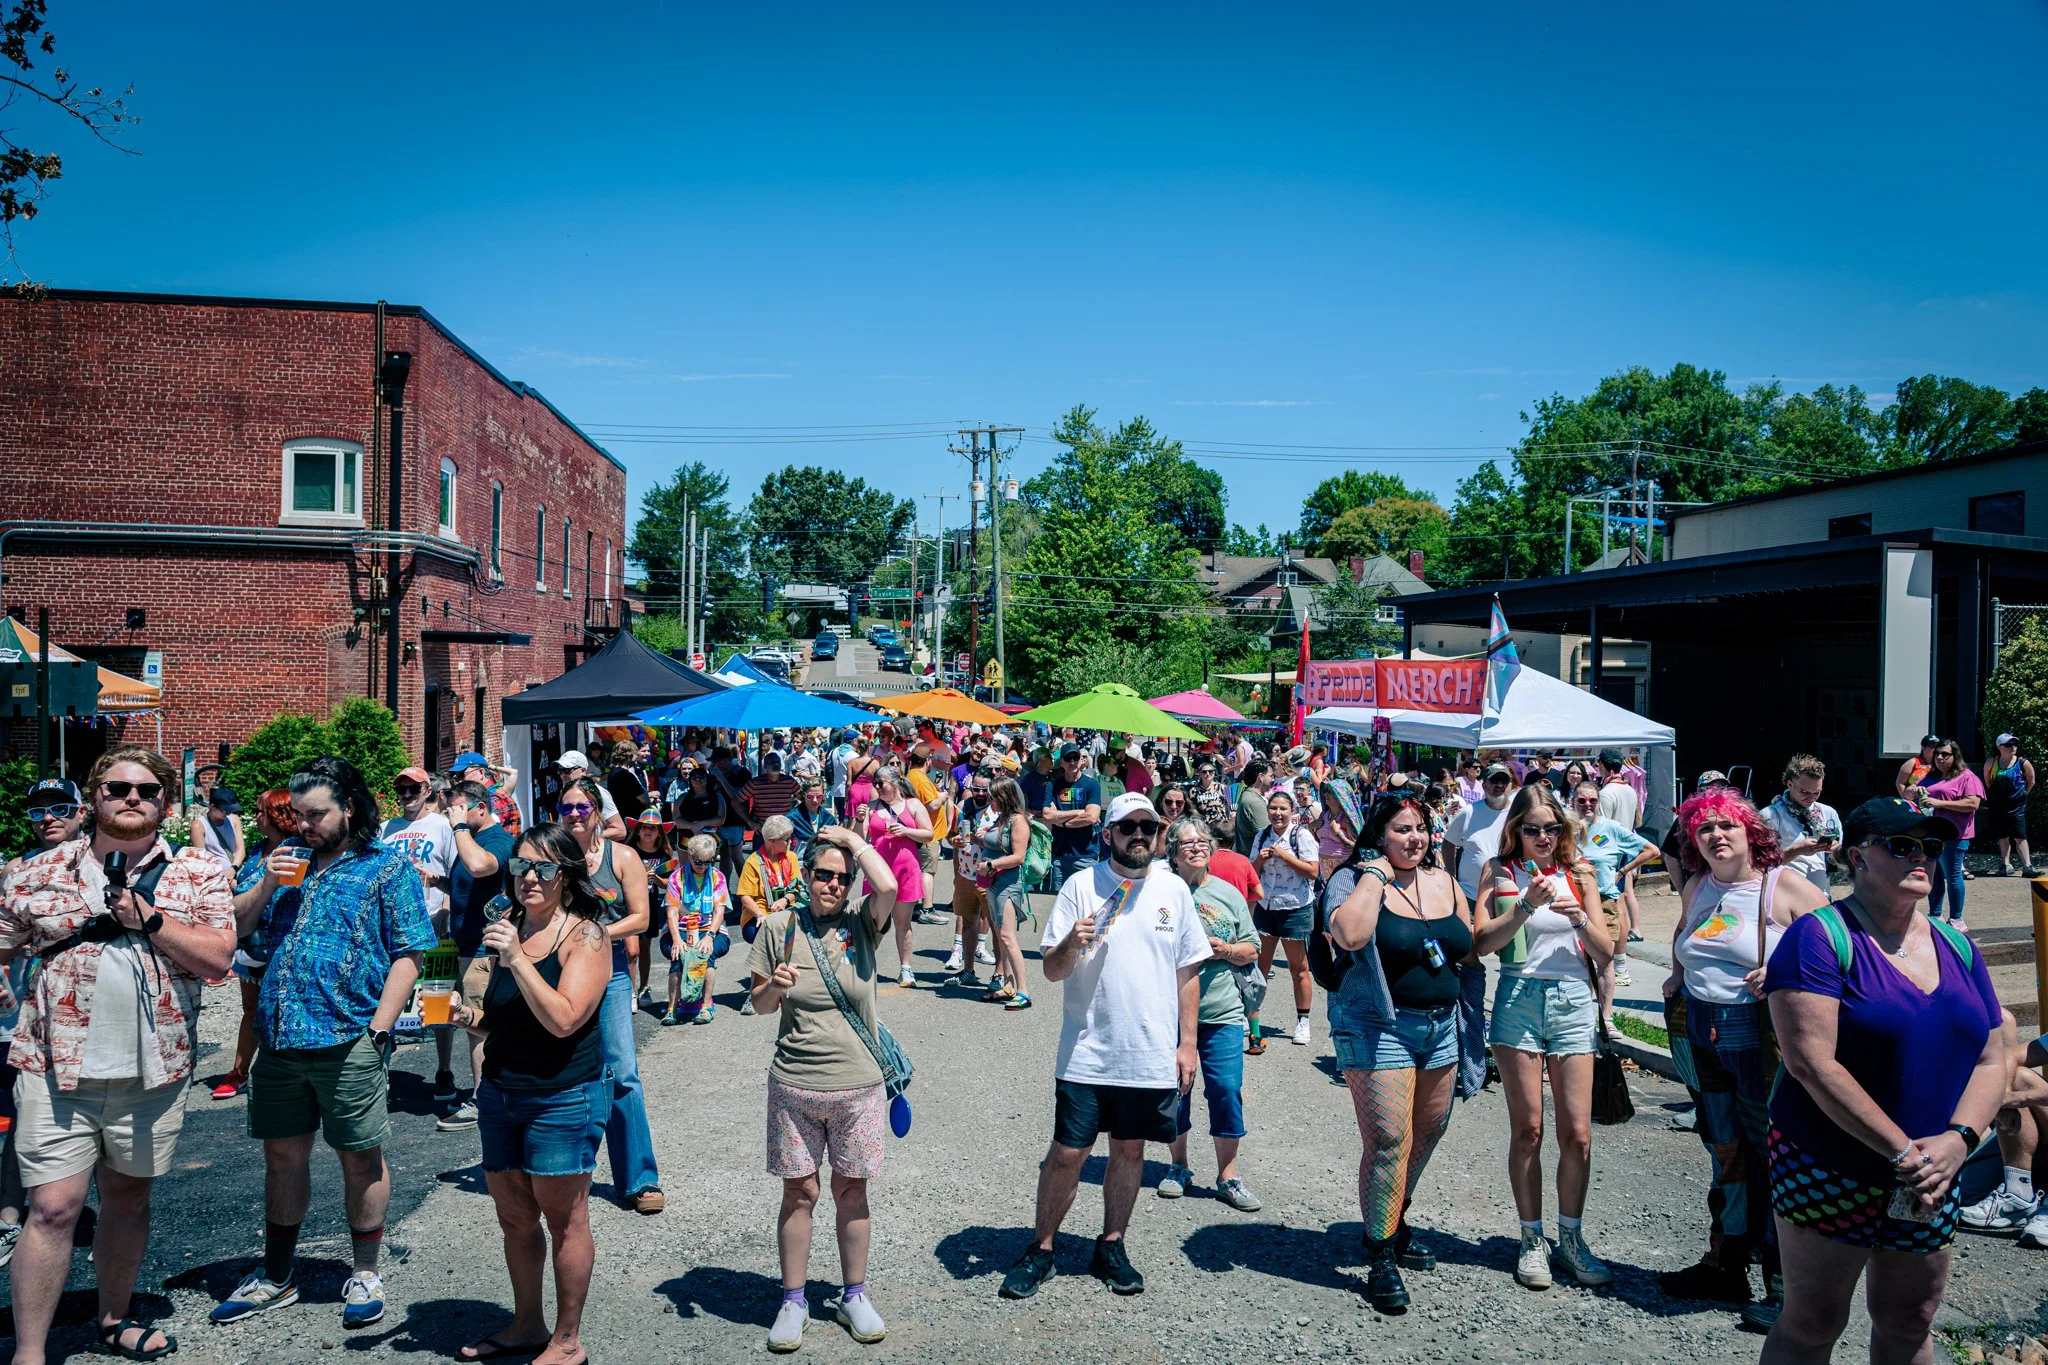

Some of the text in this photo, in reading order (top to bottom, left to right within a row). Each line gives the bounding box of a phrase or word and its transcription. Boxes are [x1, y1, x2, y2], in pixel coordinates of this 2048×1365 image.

[1317, 667, 1472, 706] PRIDE MERCH
[100, 694, 119, 705] SELL
[393, 832, 427, 840] FREDDY
